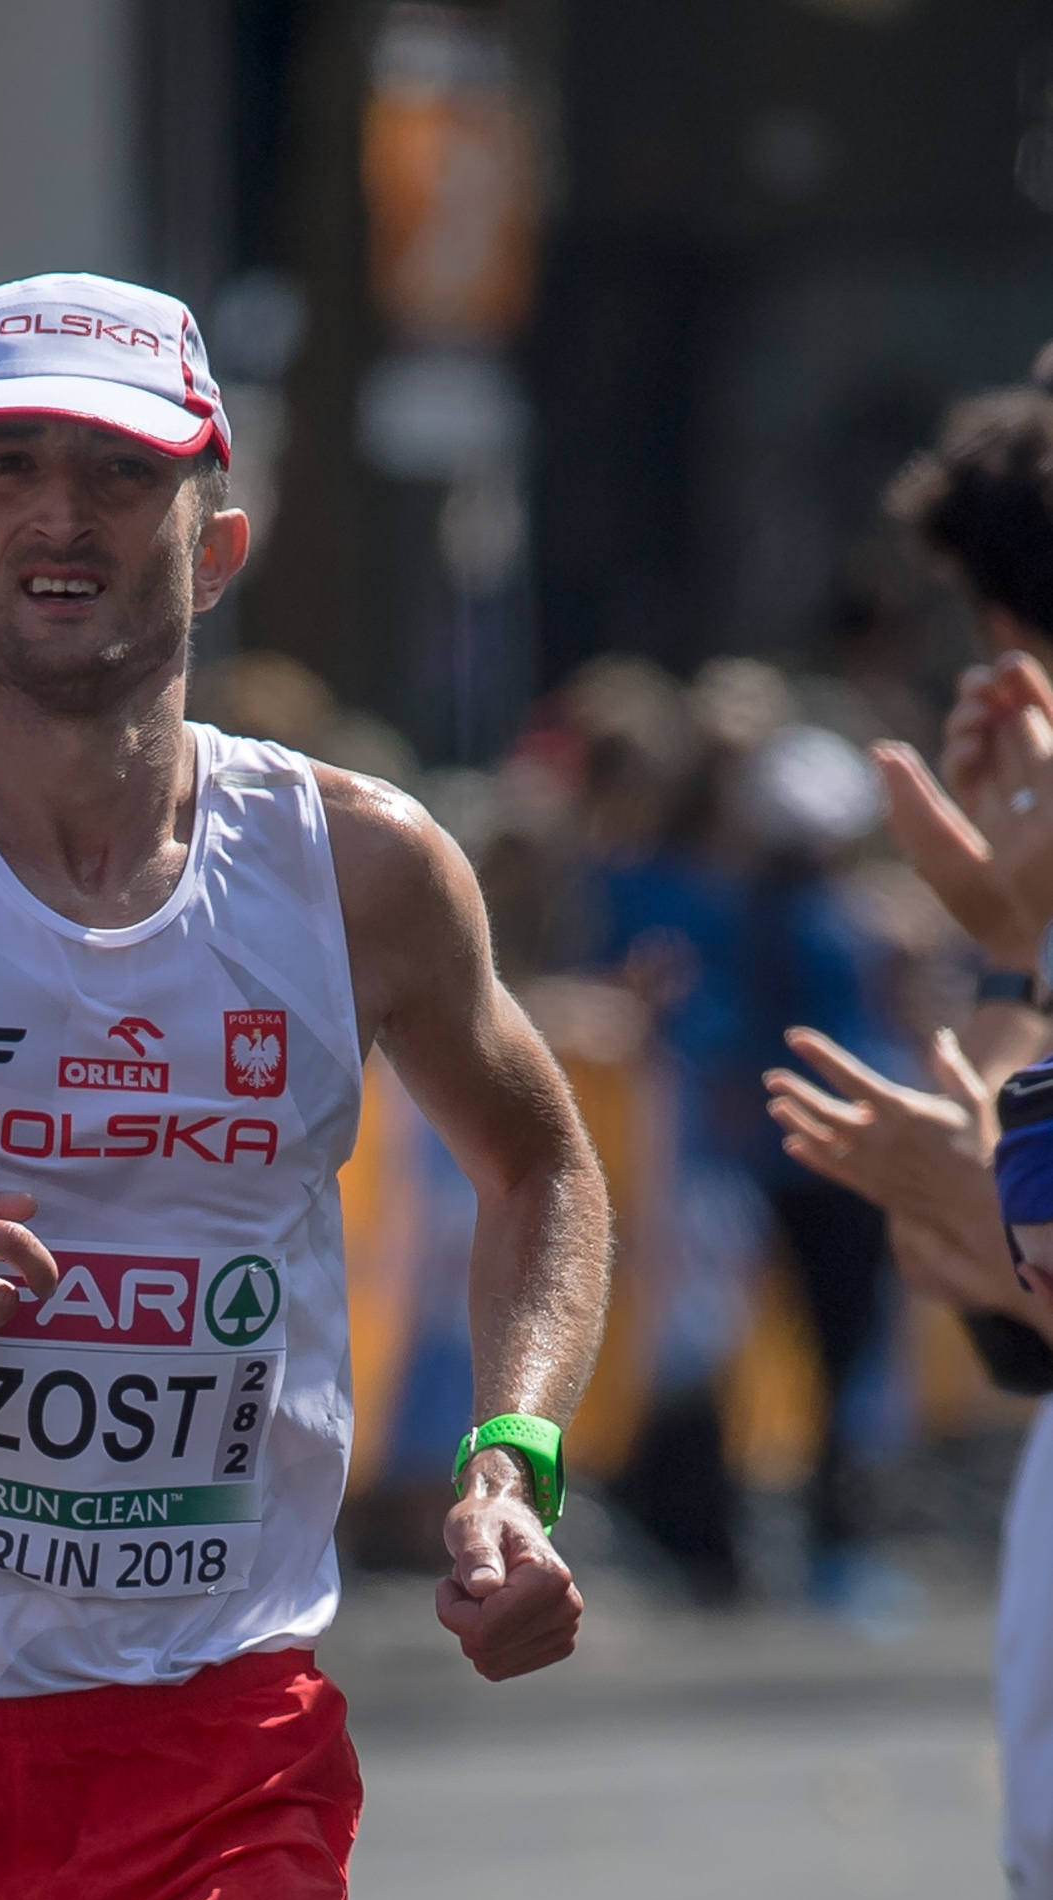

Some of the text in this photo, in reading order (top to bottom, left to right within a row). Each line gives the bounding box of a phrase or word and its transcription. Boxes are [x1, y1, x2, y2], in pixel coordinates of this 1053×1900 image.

[228, 1012, 284, 1026] POLSKA
[63, 1061, 163, 1089] ORLEN
[115, 1537, 228, 1589] 2018
